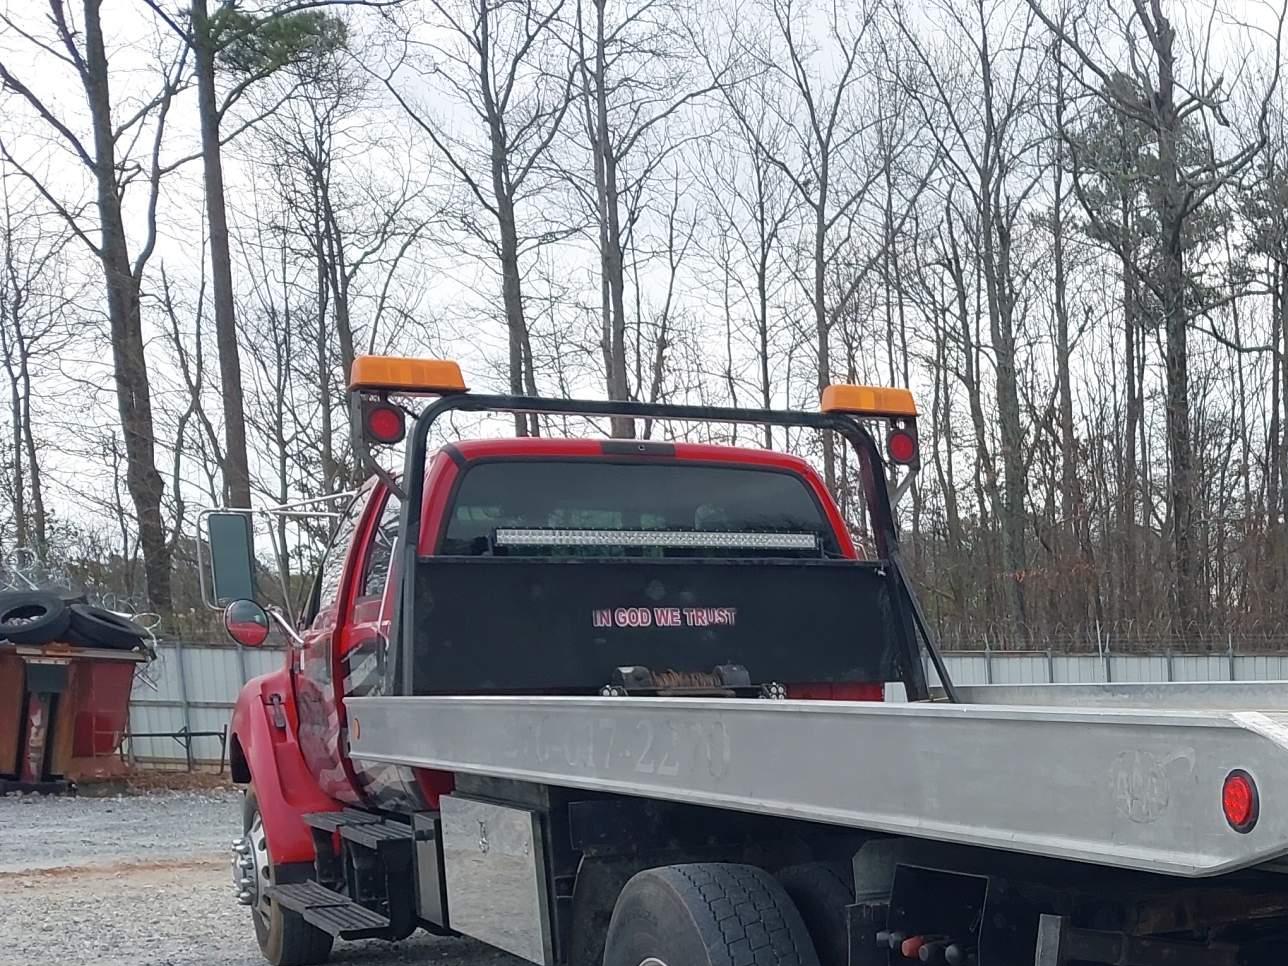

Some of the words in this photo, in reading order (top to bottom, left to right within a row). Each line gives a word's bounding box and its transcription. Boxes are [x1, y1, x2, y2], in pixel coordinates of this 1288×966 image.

[592, 608, 612, 627] IN
[614, 607, 652, 627] GOD
[653, 607, 681, 627] WE
[684, 607, 737, 626] TRUST
